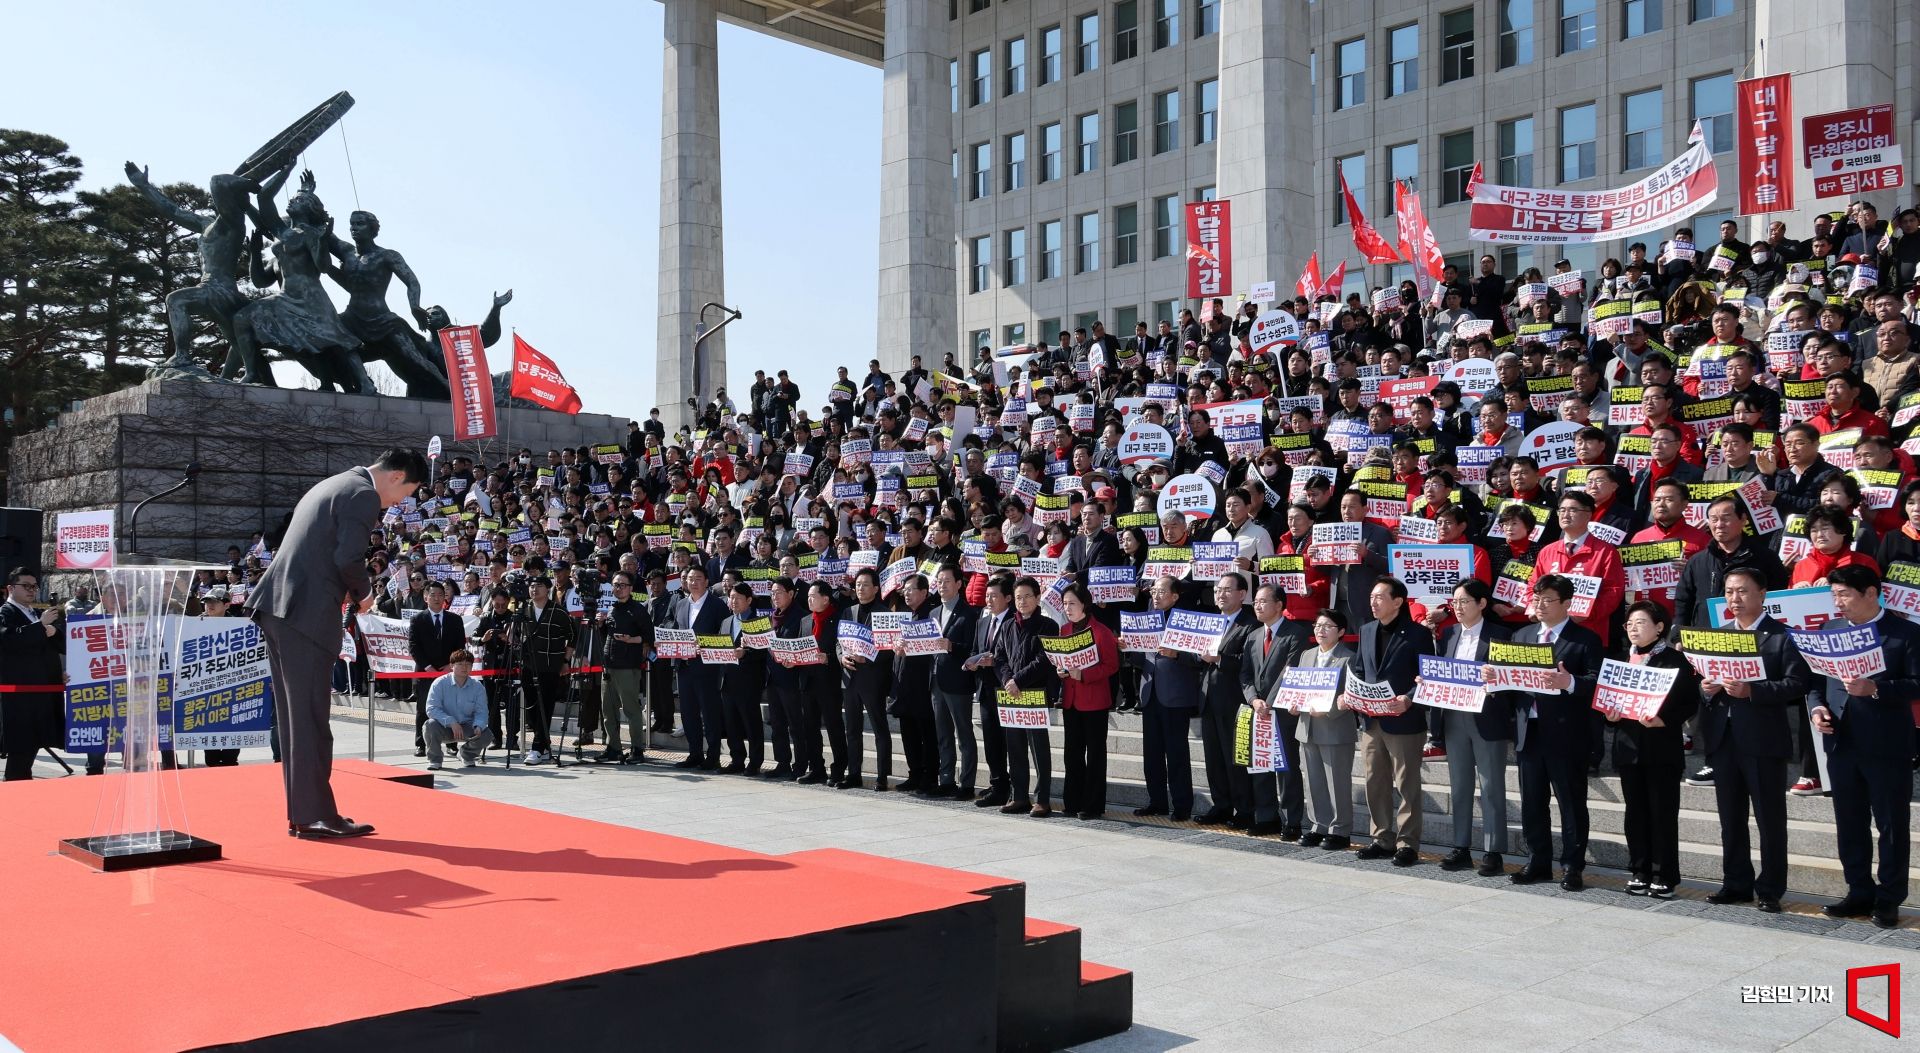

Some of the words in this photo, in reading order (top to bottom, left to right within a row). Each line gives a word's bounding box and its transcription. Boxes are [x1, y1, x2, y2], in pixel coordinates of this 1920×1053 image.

[1823, 118, 1873, 141] 경주시
[1754, 85, 1779, 205] 대구달서을
[1808, 135, 1889, 159] 당원협의회
[1845, 153, 1882, 167] 국민의힘
[1501, 189, 1566, 208] 대구·경북
[1571, 186, 1645, 208] 통합특별법
[1648, 173, 1670, 194] 통과
[1671, 157, 1692, 180] 촉구
[1818, 181, 1837, 193] 대구
[1511, 209, 1603, 232] 대구경북
[1611, 182, 1689, 227] 결의대회
[1264, 316, 1286, 328] 국민의힘
[1253, 334, 1267, 345] 대구
[1268, 324, 1295, 340] 수성구을
[1465, 367, 1492, 376] 국민의힘
[1398, 380, 1426, 391] 국민의힘
[1468, 378, 1496, 390] 중남구
[1611, 408, 1628, 423] 즉시
[1138, 431, 1162, 440] 국민의힘
[1546, 432, 1576, 444] 국민의
[1124, 443, 1141, 454] 대구
[1141, 442, 1167, 453] 북구을
[1478, 448, 1503, 463] 다퍼주고
[1528, 449, 1552, 464] 대구
[1178, 483, 1203, 494] 국민의힘
[1164, 496, 1181, 509] 대구
[1183, 494, 1209, 508] 북구을
[1684, 503, 1705, 523] 즉시
[60, 524, 109, 539] 대구경북행정통합특별법
[1333, 524, 1360, 542] 조장하는
[1400, 520, 1424, 538] 국민분열
[60, 542, 67, 553] 통과
[68, 542, 76, 553] 촉구
[77, 541, 92, 553] 대구경북
[93, 541, 109, 553] 결의대회
[1193, 543, 1215, 559] 광주전남
[1215, 543, 1238, 558] 다퍼주고
[1041, 559, 1058, 574] 조장하는
[1145, 564, 1160, 578] 즉시
[1204, 562, 1215, 577] 경북
[1403, 559, 1460, 571] 보수의심장
[1089, 568, 1111, 583] 광주전남
[1111, 568, 1135, 582] 다퍼주고
[1404, 571, 1460, 585] 상주문경
[1100, 587, 1111, 601] 경북
[1496, 579, 1513, 600] 즉시
[1137, 612, 1163, 629] 다퍼주고
[1171, 611, 1198, 630] 광주전남
[1198, 614, 1224, 632] 다퍼주고
[770, 638, 792, 653] 국민분열
[792, 638, 816, 651] 조장하는
[1164, 631, 1179, 645] 대구
[1179, 632, 1192, 648] 경북
[1680, 629, 1756, 653] 대구경북행정통합특별법
[1793, 632, 1829, 653] 광주전남
[1831, 627, 1876, 653] 다퍼주고
[181, 662, 203, 680] 국가
[205, 645, 269, 675] 주도사업으로!
[1064, 649, 1097, 669] 추진하라
[1838, 651, 1882, 679] 외면하나!
[1422, 658, 1452, 679] 광주전남
[1602, 663, 1641, 689] 국민분열
[1708, 660, 1761, 680] 추진하라
[1285, 669, 1311, 687] 광주전남
[1311, 671, 1336, 687] 다퍼주고
[70, 686, 109, 704] 20조
[184, 689, 233, 716] 광주/대구
[235, 680, 264, 701] 군공항
[1360, 681, 1391, 698] 조장하는
[1418, 682, 1435, 701] 대구
[1435, 684, 1450, 704] 경북
[1595, 687, 1635, 714] 민주당은
[72, 704, 114, 722] 지방세
[183, 715, 205, 731] 동시
[208, 707, 229, 724] 이전
[999, 709, 1015, 725] 즉시
[1015, 710, 1048, 726] 추진하라
[178, 736, 198, 747] 우리는
[230, 734, 242, 746] 님을
[243, 733, 266, 746] 믿습니다
